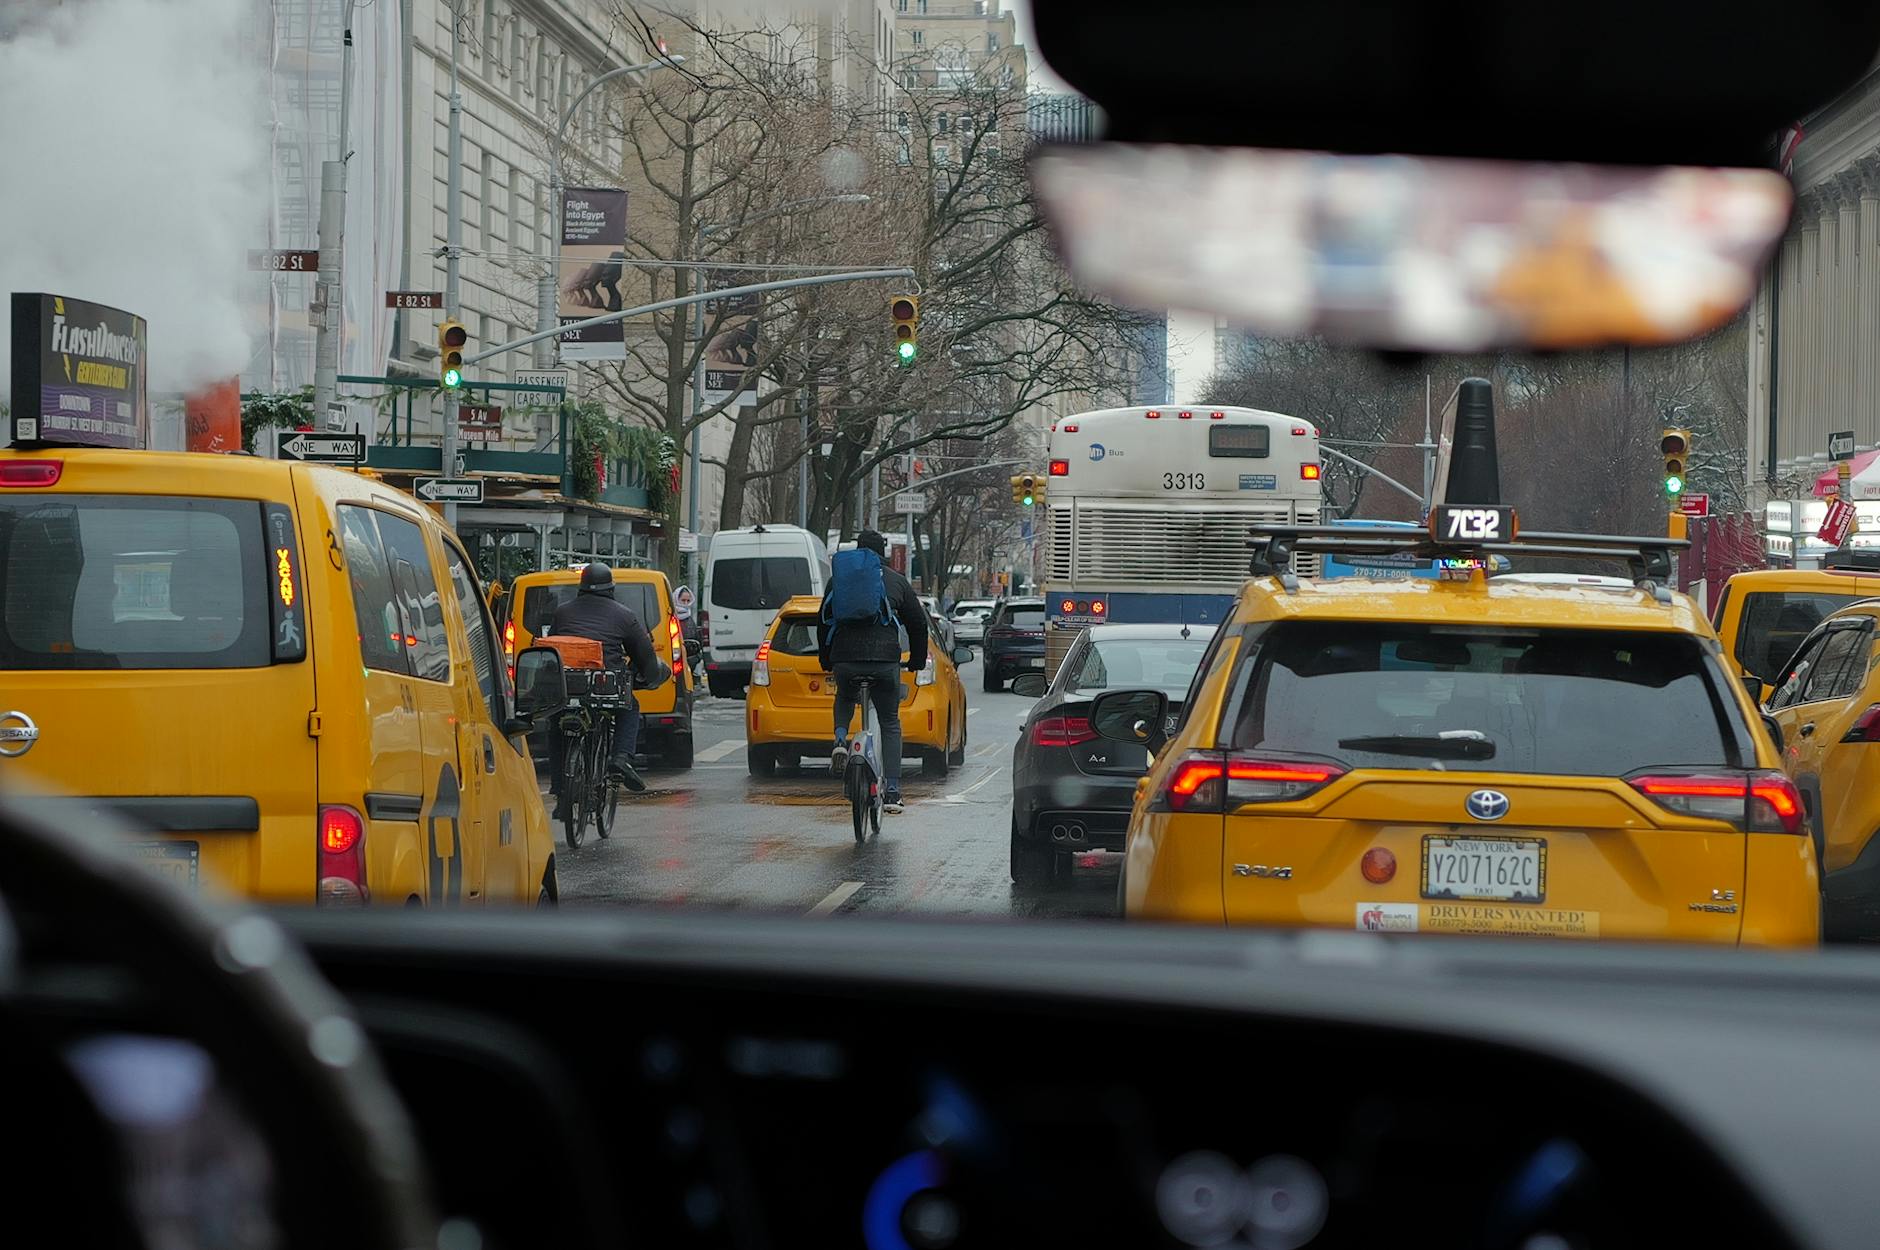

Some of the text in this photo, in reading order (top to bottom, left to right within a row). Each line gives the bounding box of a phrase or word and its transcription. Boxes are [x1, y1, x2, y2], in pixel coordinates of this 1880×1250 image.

[567, 201, 589, 210] Flight
[566, 211, 605, 220] into Egypt
[262, 256, 303, 269] E 82 St
[397, 296, 431, 307] E 82 St
[517, 394, 540, 405] CARS
[471, 409, 487, 421] 5 Av
[458, 429, 499, 442] Museum Mile
[292, 442, 356, 453] ONE WAY
[1163, 472, 1205, 490] 3313
[426, 485, 476, 495] ONE WAY
[1864, 487, 1877, 495] HOT
[1448, 509, 1500, 538] 7C32
[276, 548, 294, 606] VACANT
[1088, 754, 1106, 763] A4
[1454, 842, 1515, 853] NEW YORK
[1232, 863, 1293, 880] RAV4
[1433, 853, 1533, 886] Y207162C
[1474, 887, 1494, 895] TAXI
[1430, 905, 1585, 924] DRIVERS WANTED!
[1384, 919, 1412, 929] TAXI
[1530, 922, 1563, 933] Queens
[1566, 924, 1586, 933] Blvd
